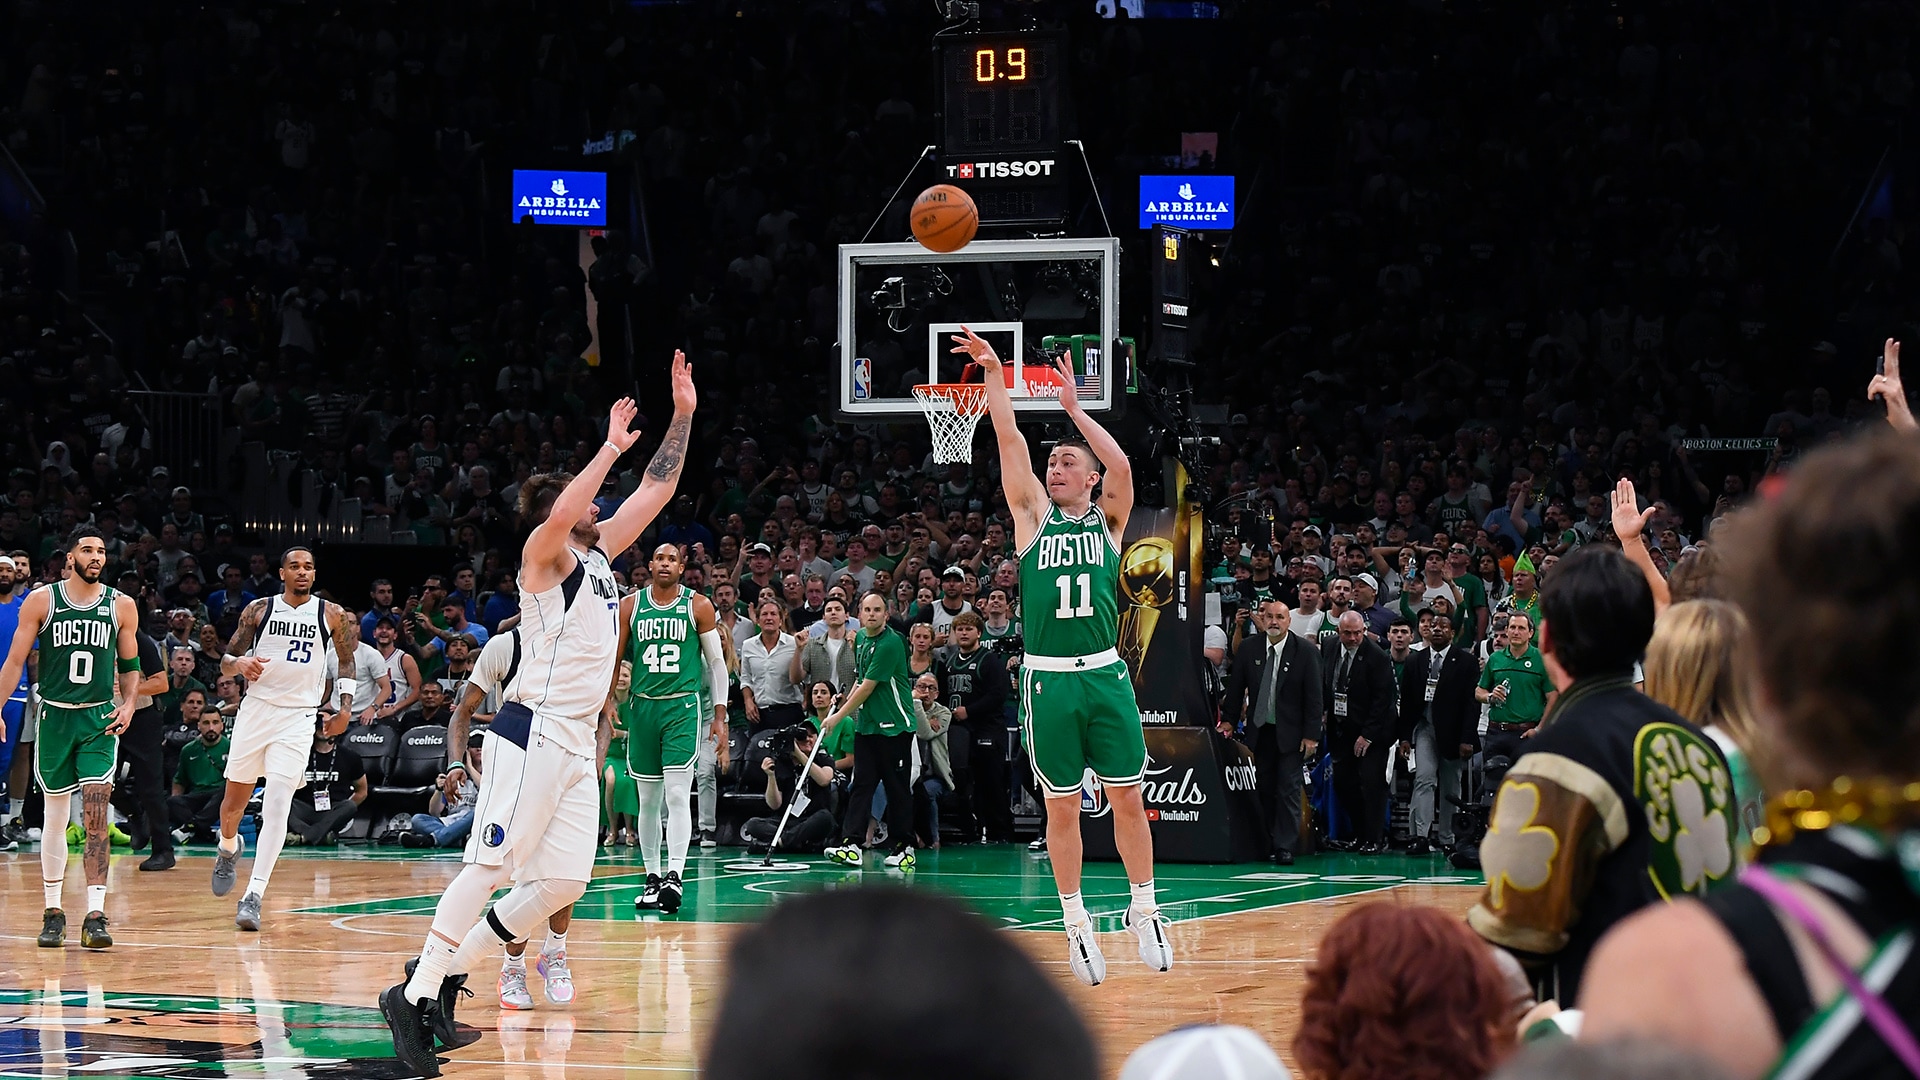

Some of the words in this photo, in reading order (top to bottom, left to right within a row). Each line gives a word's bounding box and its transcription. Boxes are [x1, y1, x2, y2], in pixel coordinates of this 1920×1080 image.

[976, 48, 1026, 82] 0.9
[975, 160, 1055, 178] TISSOT
[518, 195, 600, 209] ARBELLA
[1145, 201, 1228, 213] ARBELLA
[529, 209, 590, 217] INSURANCE
[1726, 439, 1762, 449] CELTICS
[1038, 531, 1104, 570] BOSTON
[1055, 573, 1094, 619] 11
[53, 619, 112, 650] BOSTON
[269, 620, 317, 639] DALLAS
[637, 618, 687, 642] BOSTON
[286, 639, 314, 664] 25
[642, 644, 680, 673] 42
[69, 650, 94, 685] 0
[1140, 710, 1177, 724] uTubeTV
[350, 733, 384, 744] @celtics
[407, 735, 443, 746] @celtics
[1230, 872, 1482, 884] BOS
